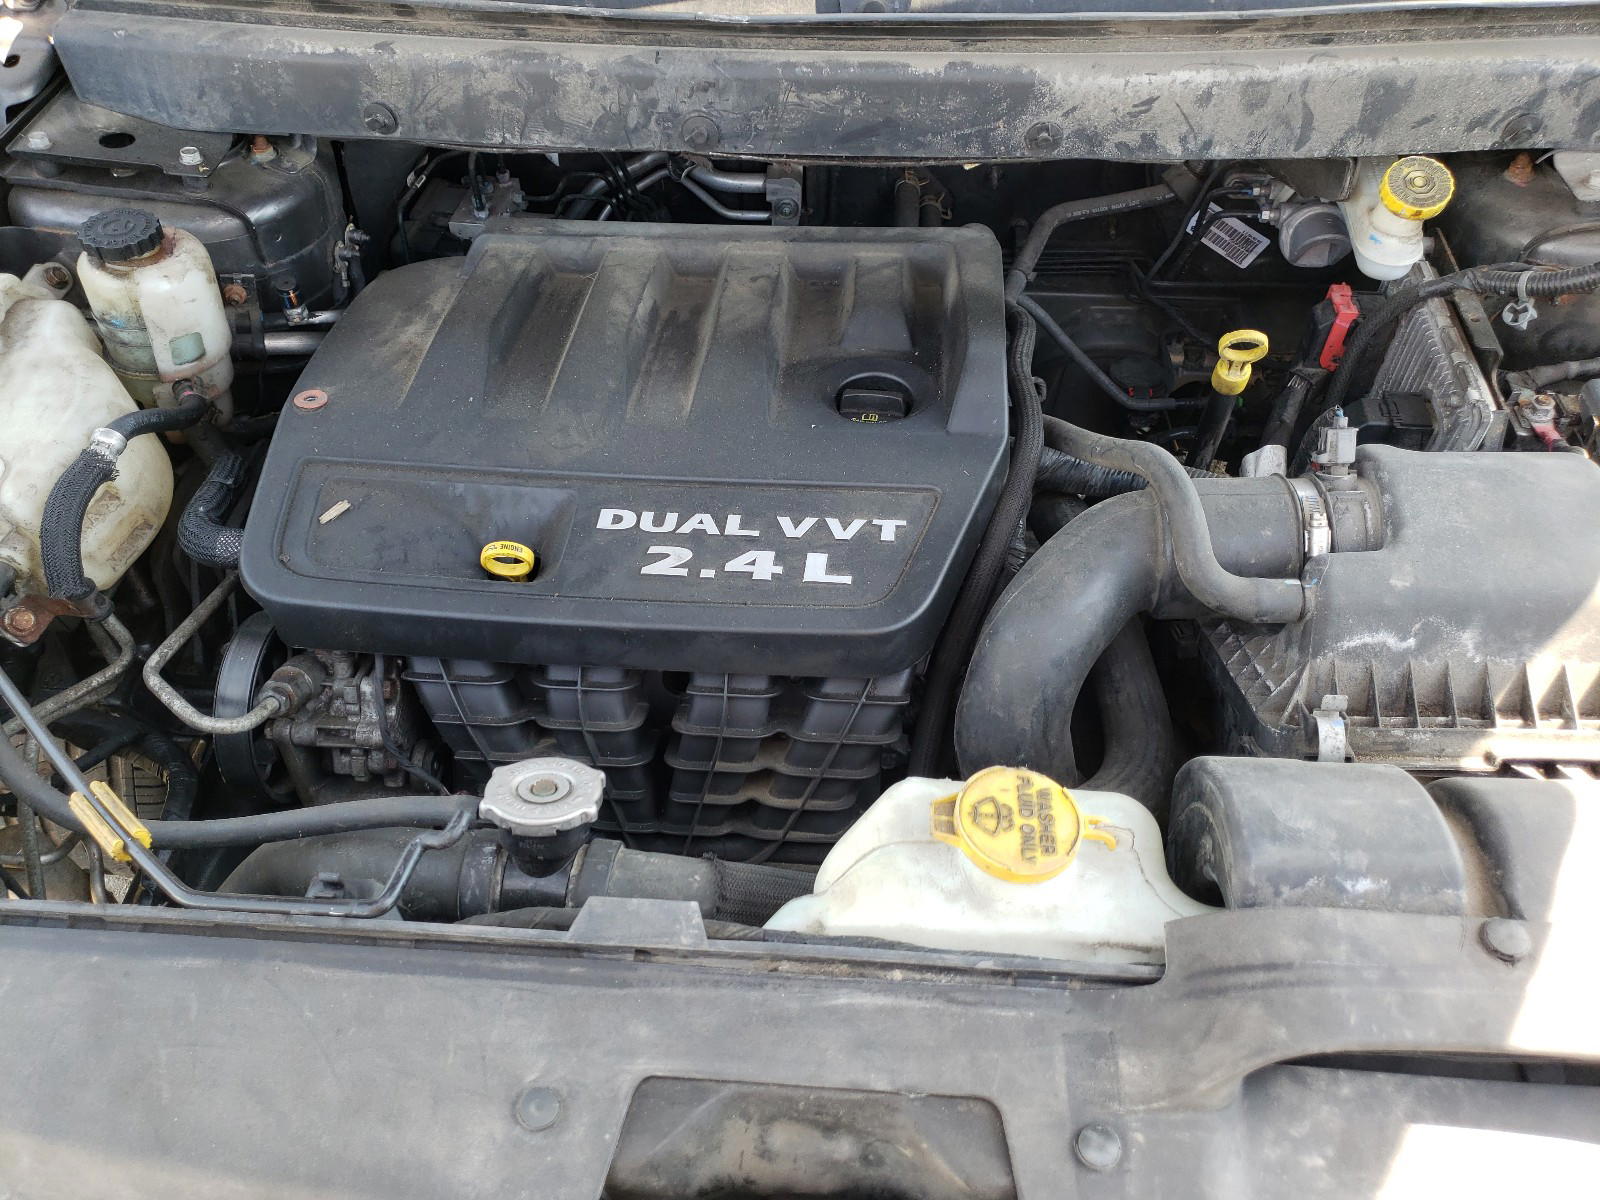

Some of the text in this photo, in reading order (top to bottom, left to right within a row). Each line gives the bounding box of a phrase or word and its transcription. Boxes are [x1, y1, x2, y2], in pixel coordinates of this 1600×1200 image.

[595, 508, 908, 542] DUAL VVT
[499, 543, 523, 553] ENGINE
[640, 545, 855, 585] 2.4 L
[1016, 775, 1037, 864] FLUID ONLY
[1037, 788, 1057, 856] WASHER
